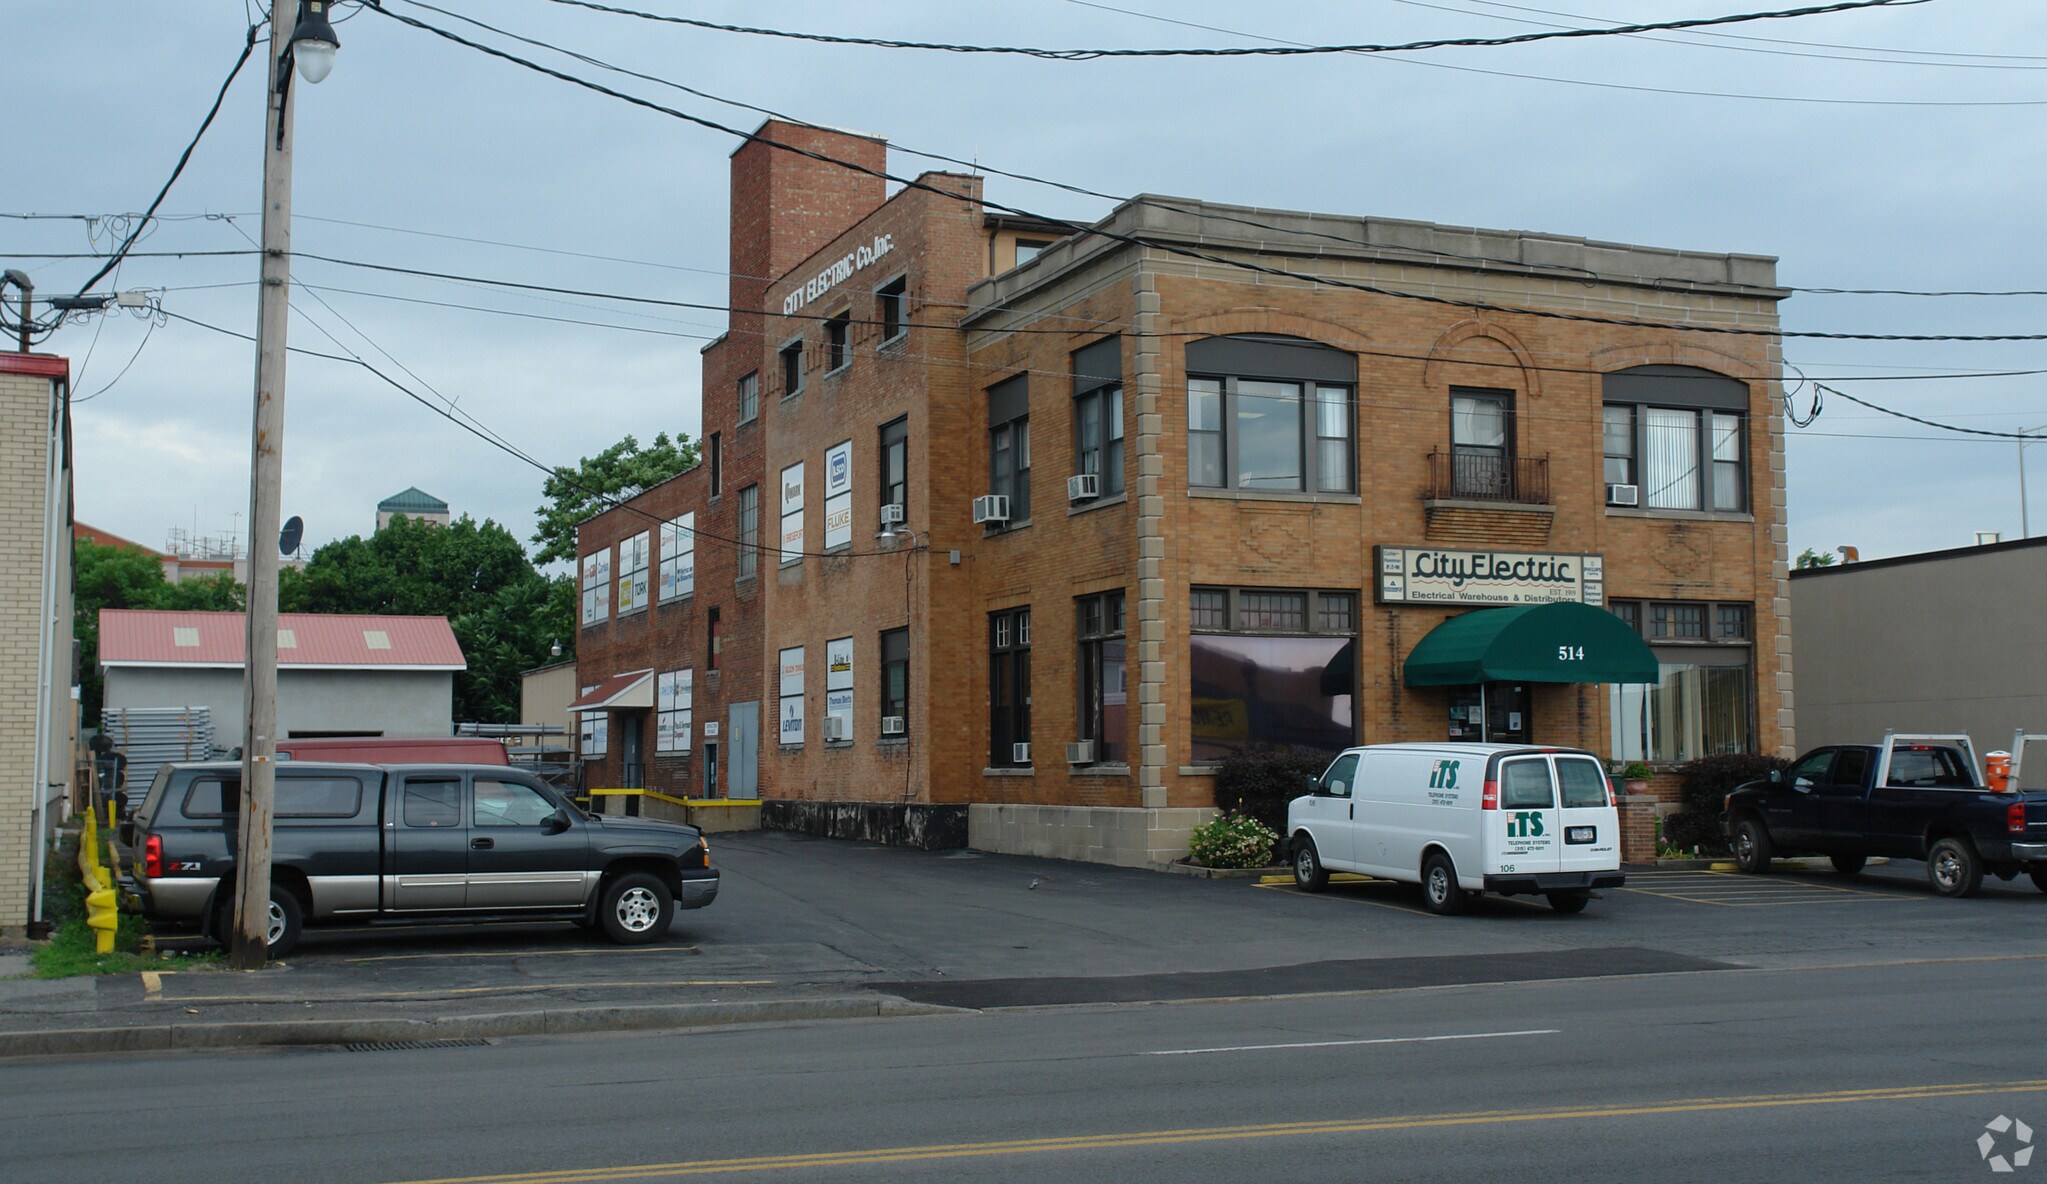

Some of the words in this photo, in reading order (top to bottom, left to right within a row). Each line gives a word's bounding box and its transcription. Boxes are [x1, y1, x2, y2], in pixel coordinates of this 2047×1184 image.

[783, 285, 805, 318] CITY
[806, 253, 855, 304] ELECTRIC
[826, 512, 849, 530] FLUKE
[634, 581, 648, 597] TORK
[1412, 591, 1455, 600] Electrical
[1459, 592, 1509, 601] Warehouse
[1524, 594, 1576, 603] Distributors
[1558, 646, 1584, 661] 514
[168, 861, 201, 870] Z71
